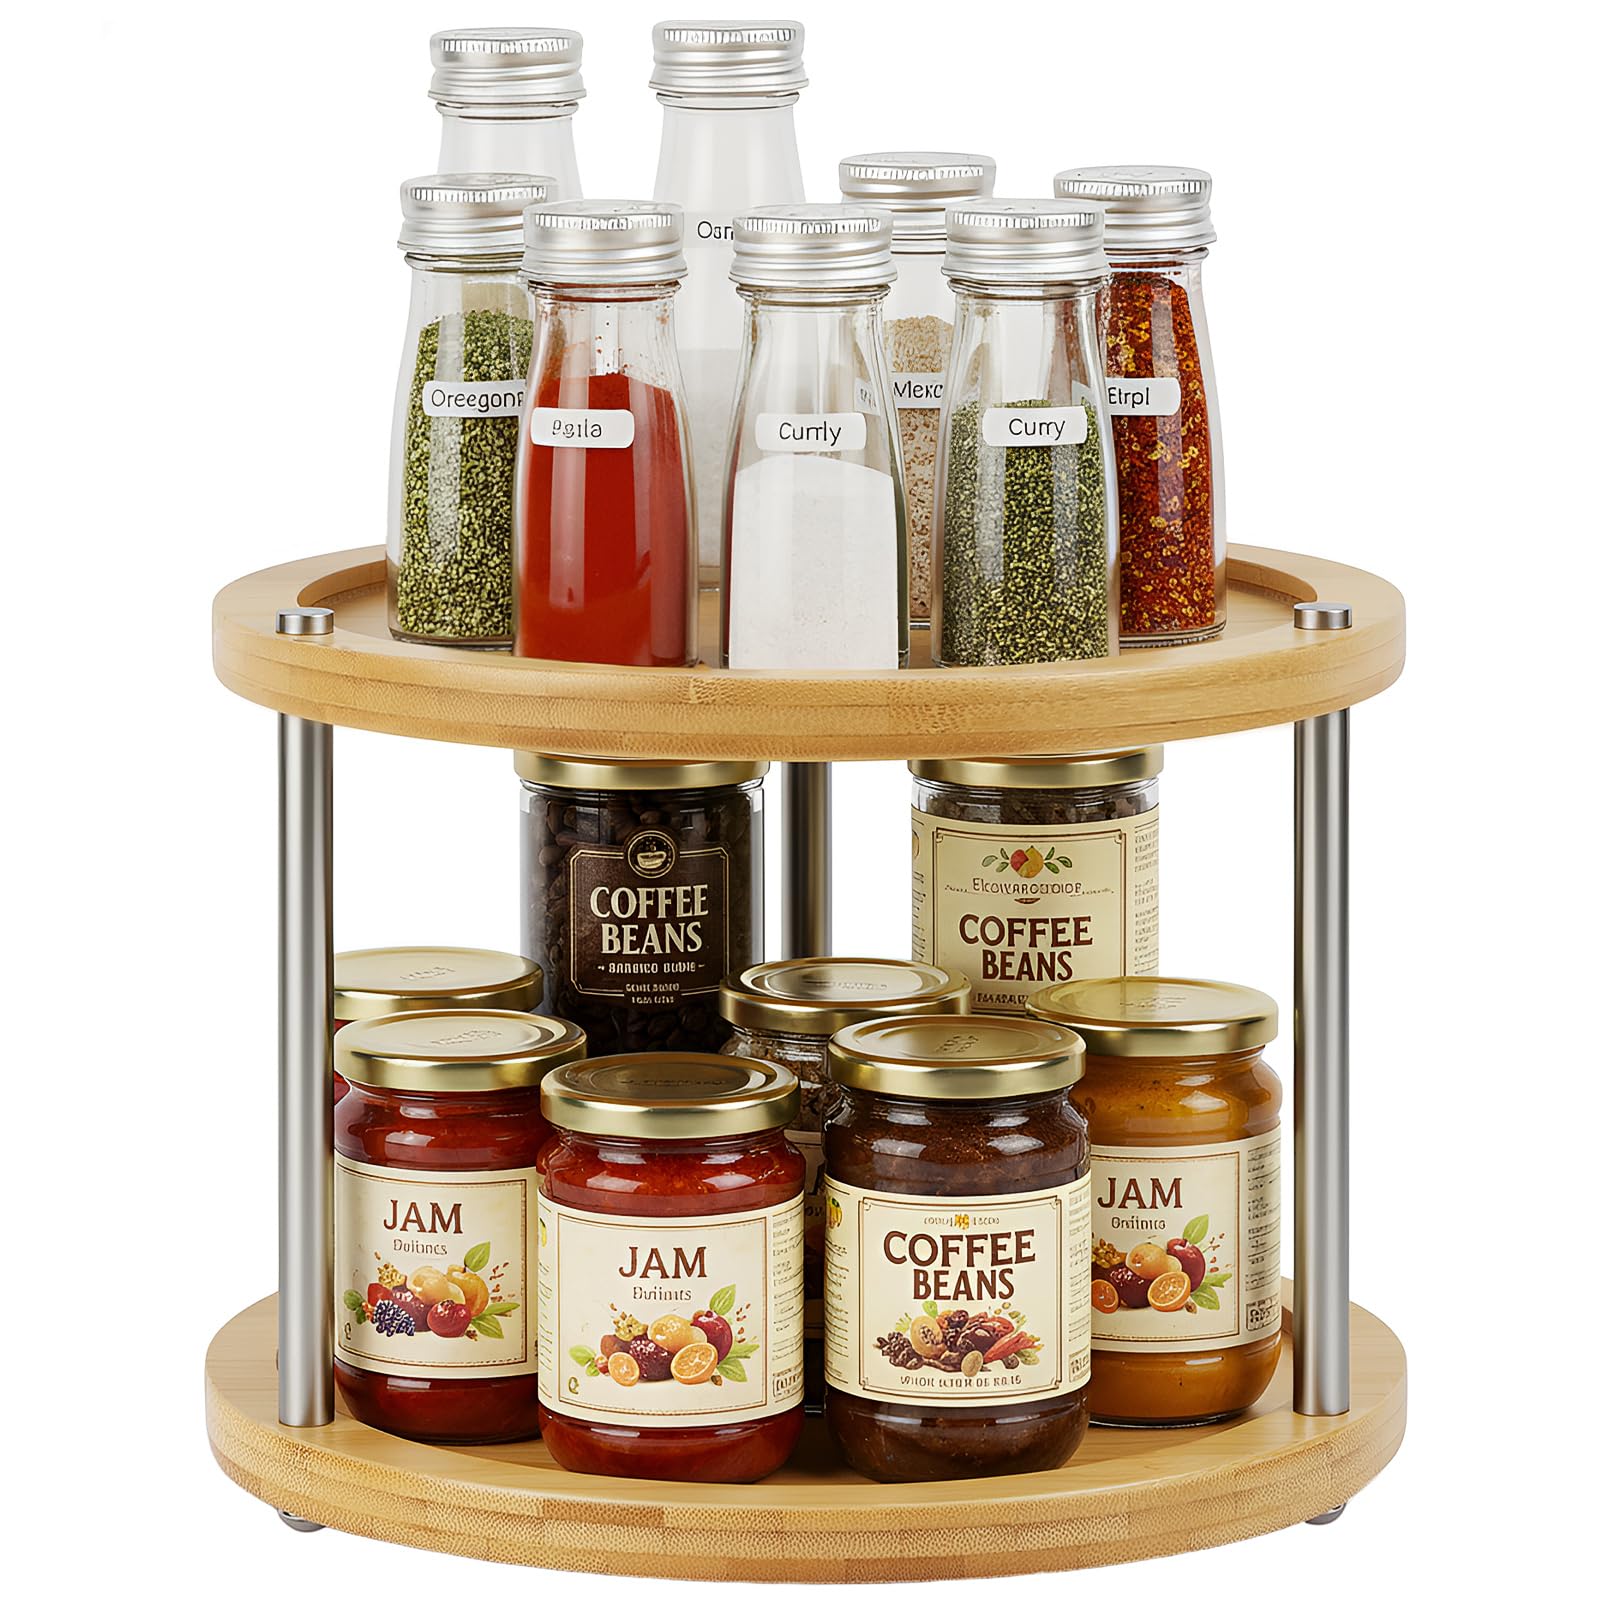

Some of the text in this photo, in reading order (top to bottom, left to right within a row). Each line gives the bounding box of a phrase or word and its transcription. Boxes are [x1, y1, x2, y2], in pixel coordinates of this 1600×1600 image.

[1008, 418, 1066, 441] Curry
[589, 884, 709, 920] COFFEE
[600, 921, 703, 955] BEANS
[958, 913, 1094, 948] COFFEE
[982, 948, 1074, 982] BEANS
[1097, 1177, 1184, 1210] JAM
[383, 1199, 464, 1234] JAM
[618, 1246, 708, 1279] JAM
[883, 1228, 1037, 1268] COFFEE
[912, 1267, 1015, 1301] BEANS
